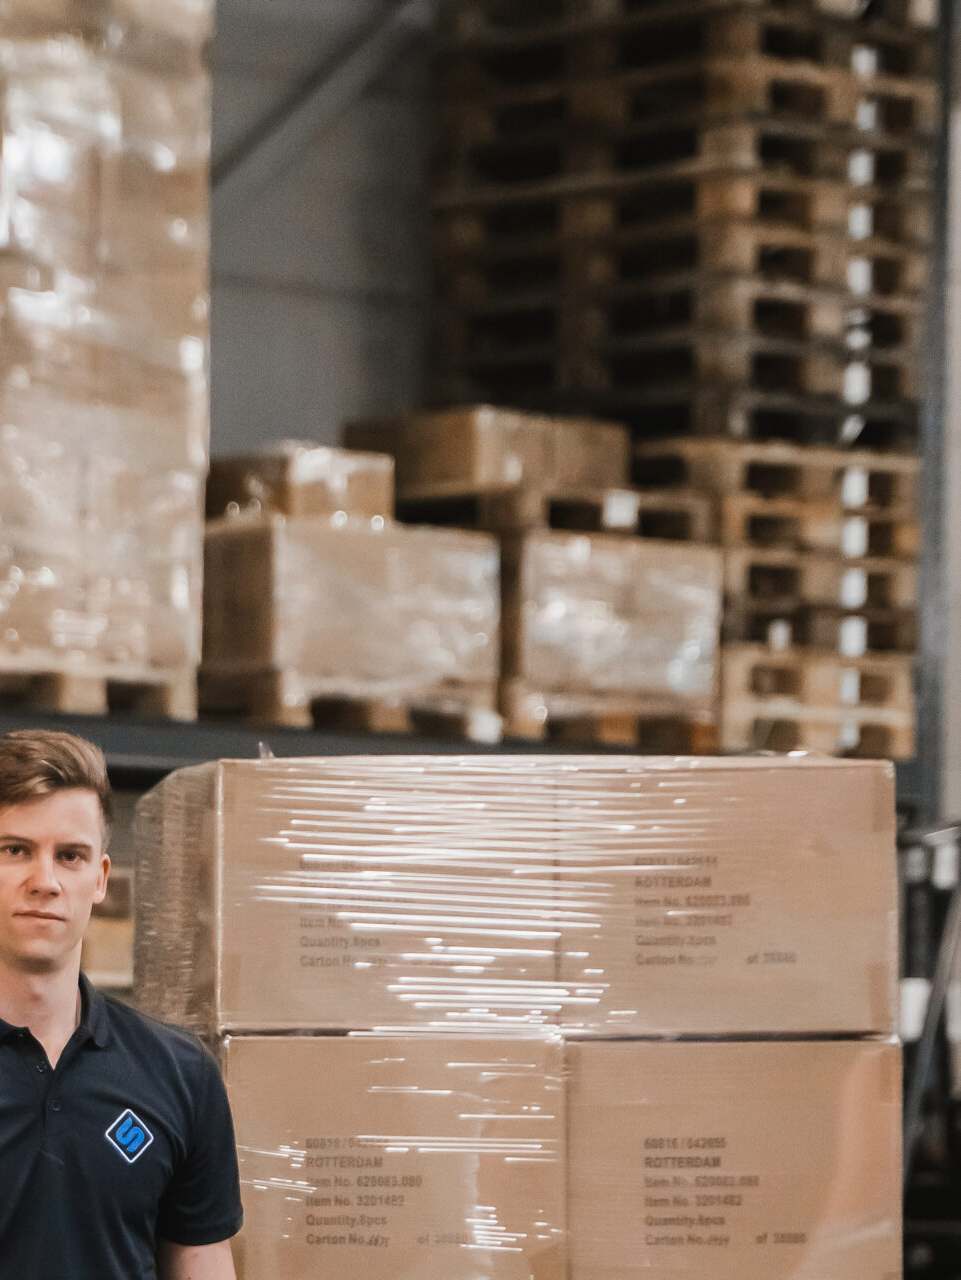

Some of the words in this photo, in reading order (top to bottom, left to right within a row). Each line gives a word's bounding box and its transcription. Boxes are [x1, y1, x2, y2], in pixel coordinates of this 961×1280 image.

[634, 876, 712, 888] ROTTERDAM
[306, 1156, 384, 1168] ROTTERDAM
[644, 1156, 722, 1169] ROTTERDAM
[334, 1176, 353, 1188] No.
[307, 1195, 332, 1207] Item
[306, 1233, 346, 1246] Carton
[755, 1232, 769, 1245] of
